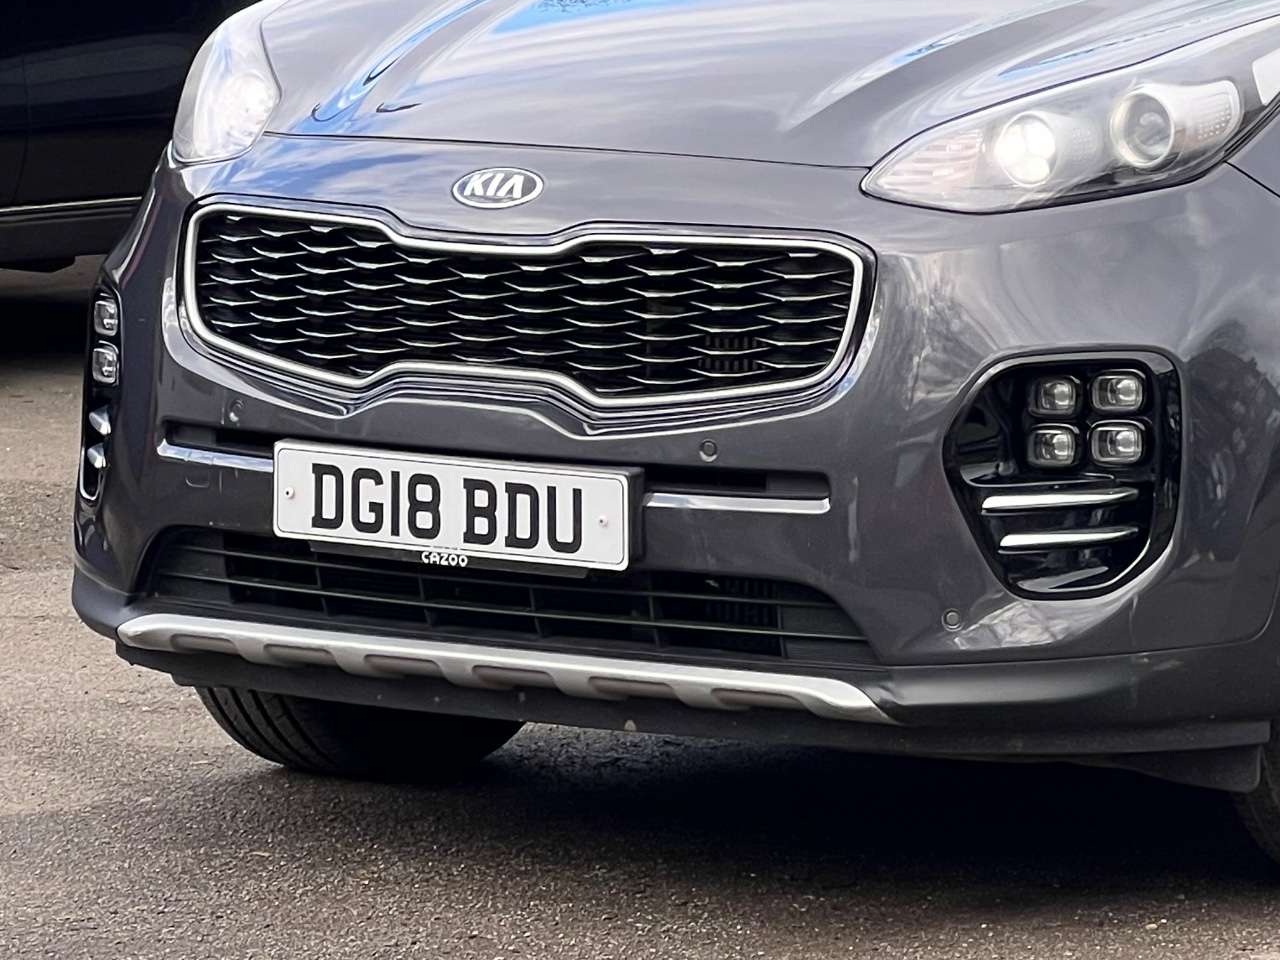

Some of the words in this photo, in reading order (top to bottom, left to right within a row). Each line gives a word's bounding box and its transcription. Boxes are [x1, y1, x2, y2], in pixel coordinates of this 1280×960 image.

[463, 172, 525, 199] KIA
[311, 462, 441, 540] DG18
[463, 477, 583, 554] BDU
[421, 551, 468, 567] CAZOO
